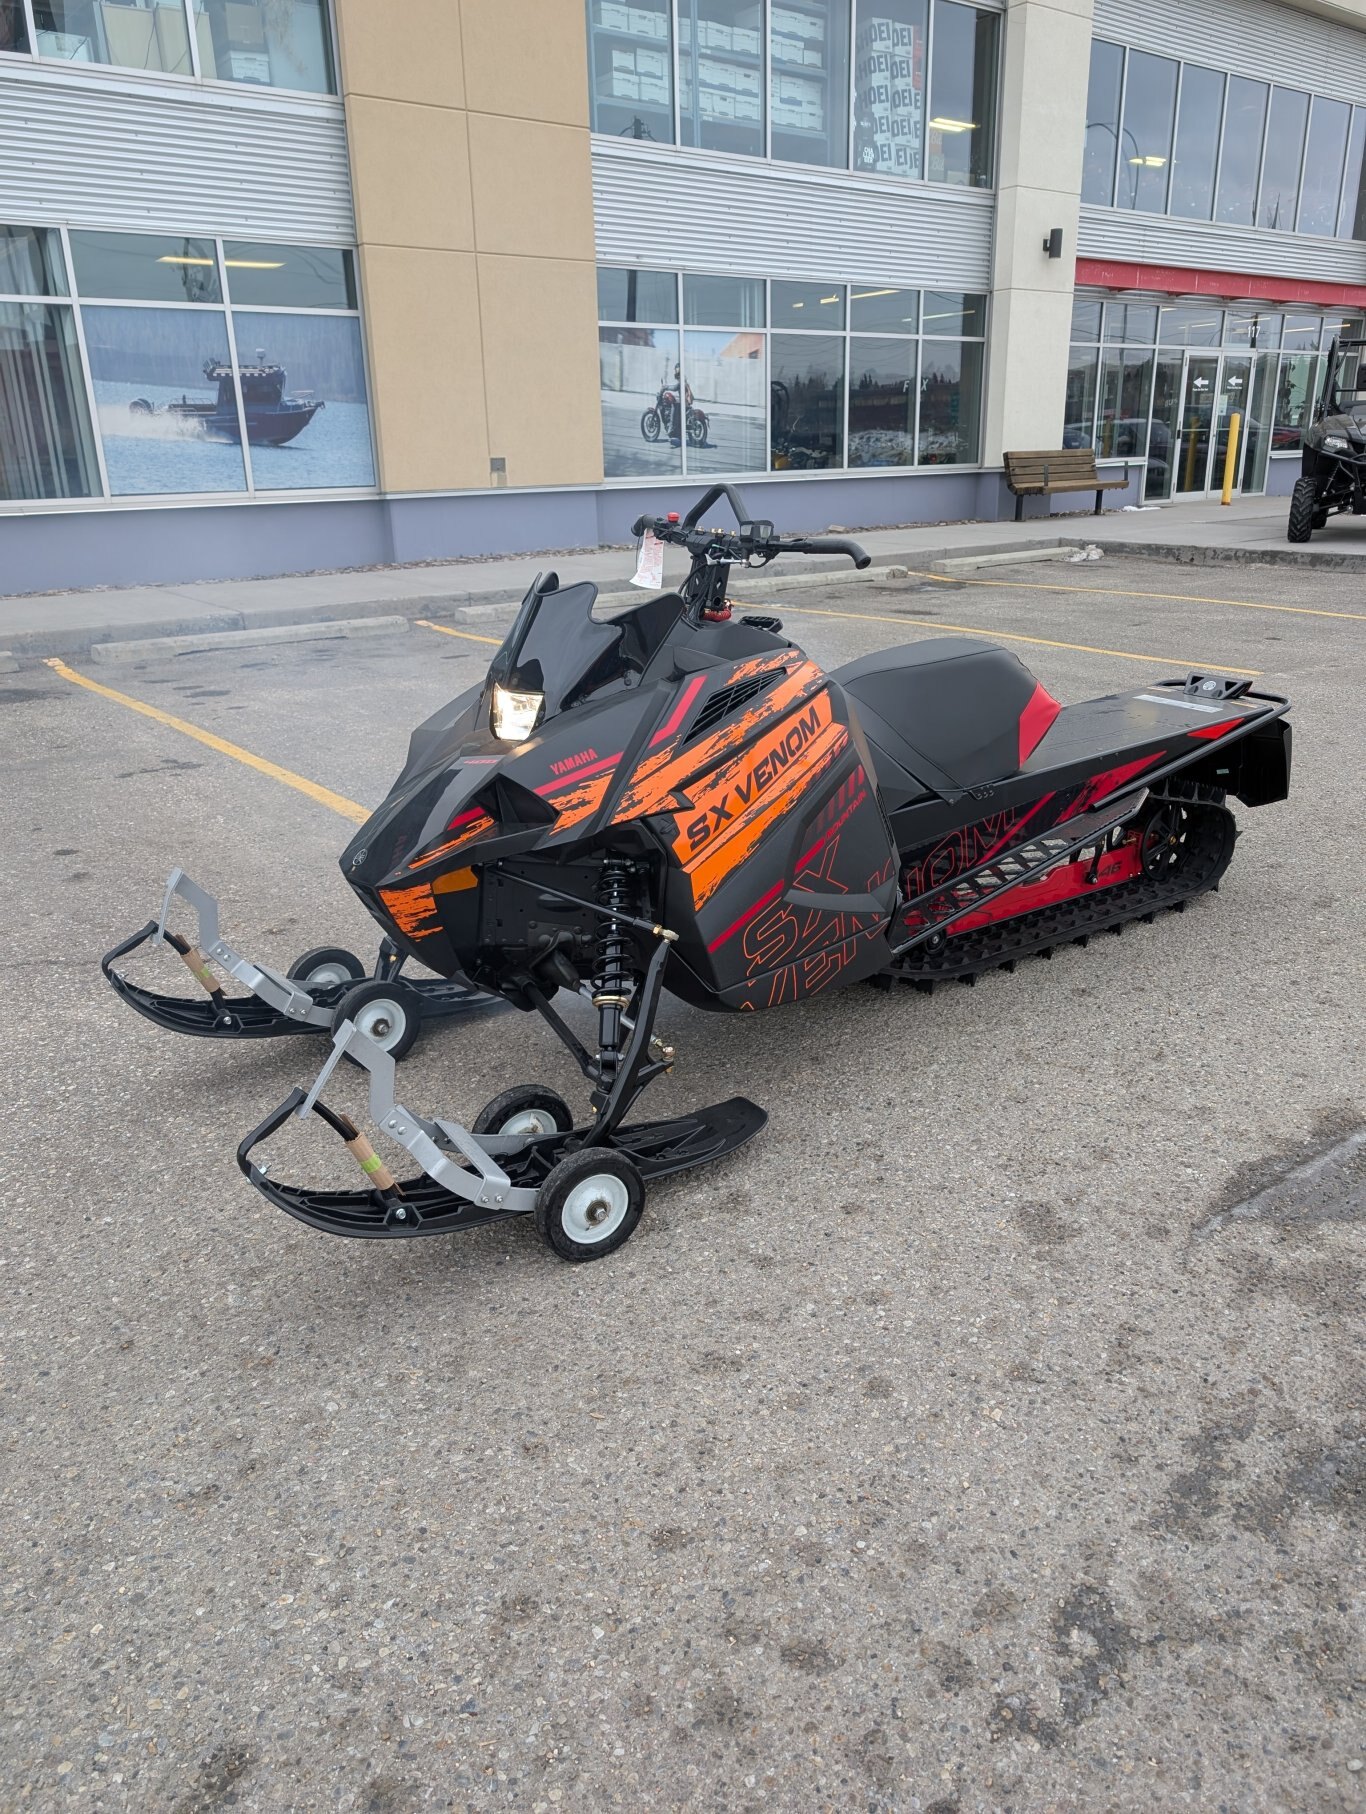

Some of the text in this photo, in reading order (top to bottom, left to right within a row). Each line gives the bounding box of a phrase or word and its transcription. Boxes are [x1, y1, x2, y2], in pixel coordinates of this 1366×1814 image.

[1247, 325, 1261, 338] 117
[902, 379, 929, 393] FX
[549, 747, 599, 776] YAMAHA
[686, 705, 822, 853] SX VENOM
[826, 789, 868, 840] MOUNTAIN
